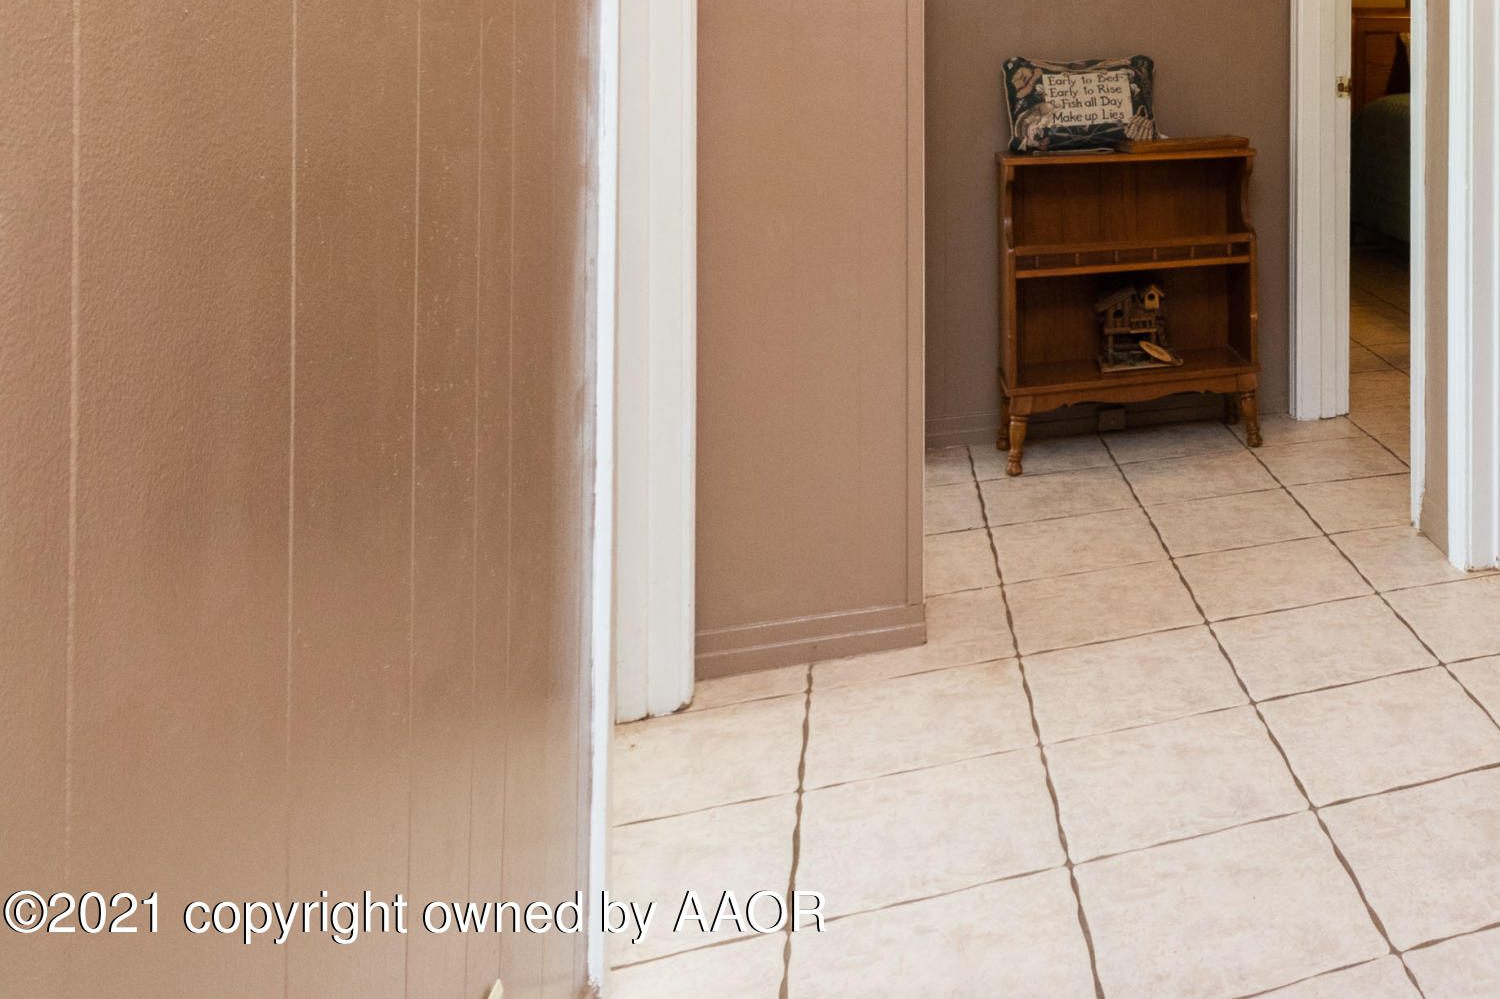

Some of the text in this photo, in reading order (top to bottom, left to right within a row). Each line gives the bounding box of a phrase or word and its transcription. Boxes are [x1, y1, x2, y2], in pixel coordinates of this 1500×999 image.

[1048, 76, 1076, 88] Early
[1081, 76, 1092, 84] to
[1050, 84, 1122, 98] Early to Rise
[1061, 99, 1082, 109] Fish
[1084, 97, 1097, 108] all
[1100, 96, 1123, 109] Day
[1053, 109, 1125, 125] Make up Lies
